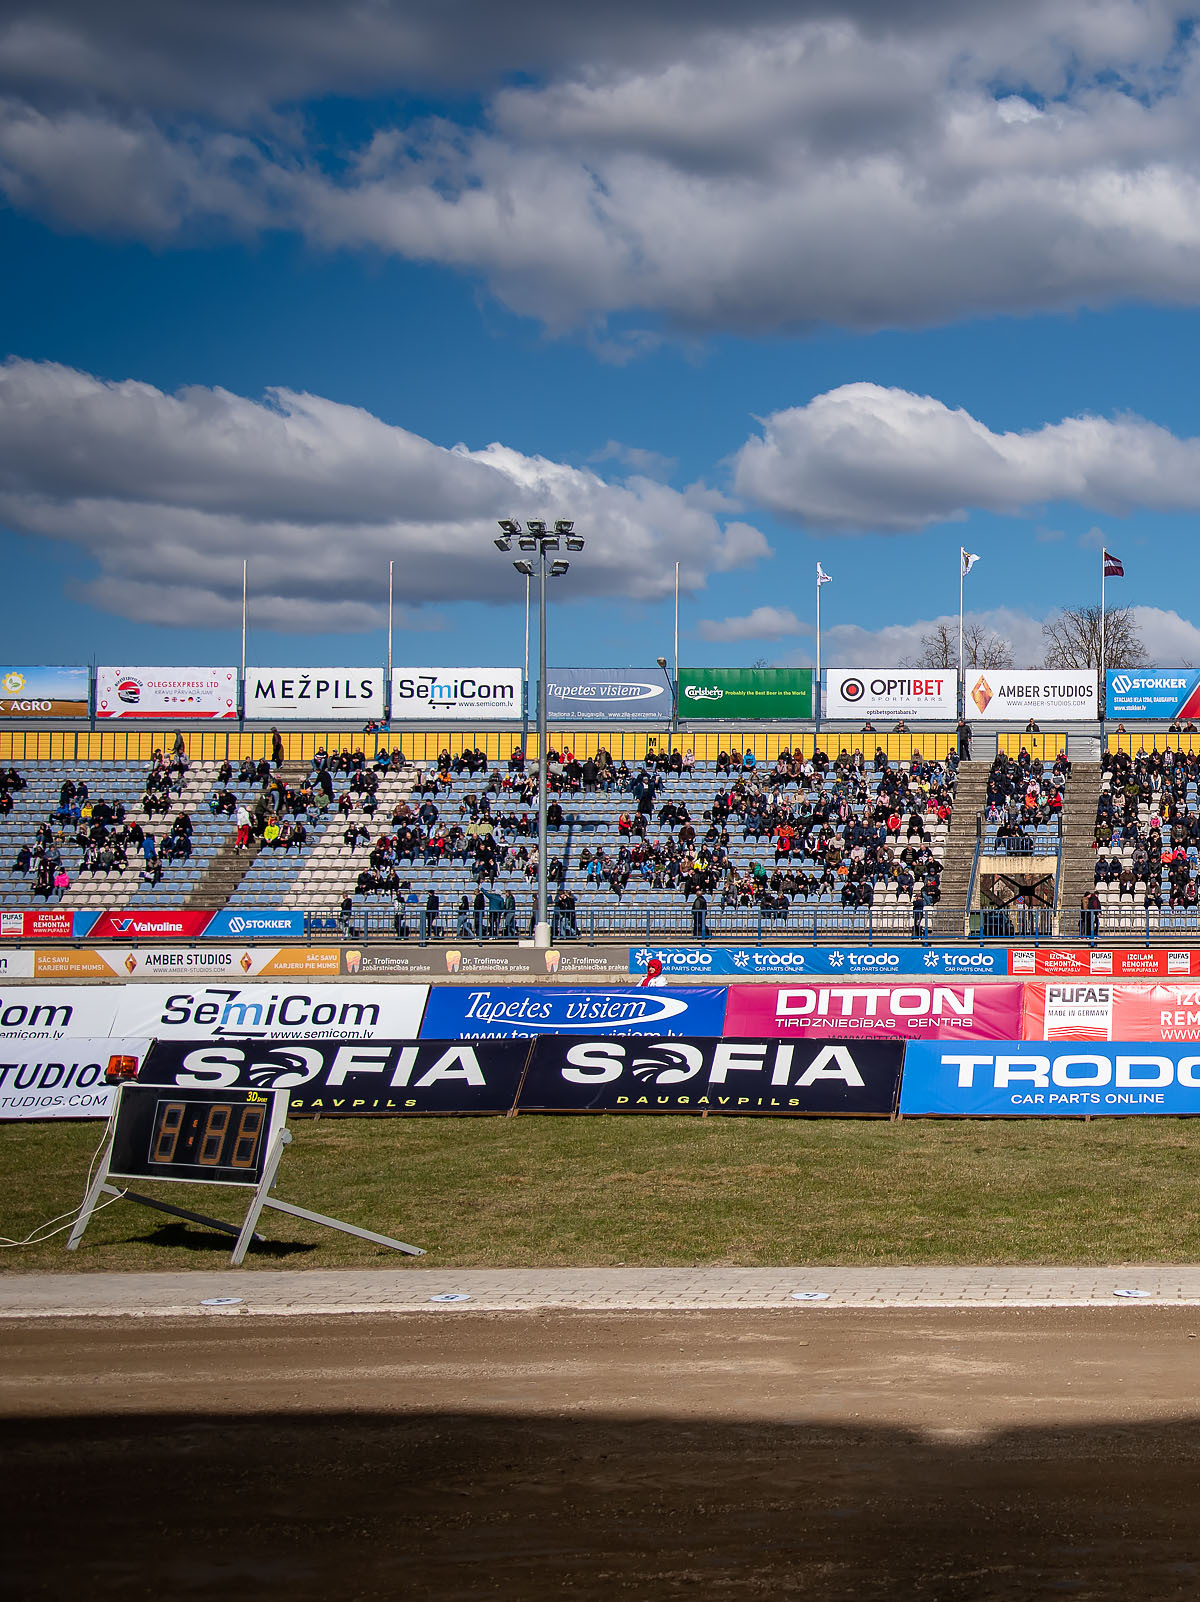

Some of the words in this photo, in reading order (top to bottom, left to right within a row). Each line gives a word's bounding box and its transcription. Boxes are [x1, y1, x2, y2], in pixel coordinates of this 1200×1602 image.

[255, 674, 373, 698] MEŽPILS
[399, 679, 514, 699] SemiCom
[870, 679, 943, 696] OPTIBET
[1131, 678, 1187, 689] STOKKER
[547, 684, 596, 700] Tapetes
[599, 685, 641, 696] visiem
[685, 685, 723, 700] Carlsberg
[999, 685, 1040, 697] AMBER
[1043, 685, 1093, 698] STUDIOS
[10, 700, 53, 711] AGRO
[648, 737, 656, 746] M
[1033, 738, 1038, 747] L
[2, 913, 23, 921] PUFAS
[38, 914, 65, 922] IZCILAM
[133, 922, 183, 932] Valvoline
[246, 920, 292, 929] STOKKER
[145, 954, 185, 966] AMBER
[187, 953, 232, 965] STUDIOS
[656, 951, 712, 965] trodo
[752, 952, 804, 965] trodo
[850, 952, 899, 965] trodo
[942, 952, 994, 965] trodo
[775, 987, 975, 1016] DITTON
[1049, 988, 1109, 1003] PUFAS
[161, 995, 381, 1026] SemiCom
[465, 991, 552, 1023] Tapetes
[566, 996, 647, 1019] visiem
[1048, 1009, 1066, 1017] MADE
[1068, 1009, 1076, 1017] IN
[1077, 1009, 1108, 1017] GERMANY
[775, 1017, 896, 1028] TIRDZNIECĪBAS
[907, 1017, 973, 1028] CENTRS
[270, 1029, 374, 1040] www.semicom.lv
[290, 1098, 418, 1108] GAVPILS
[616, 1095, 800, 1107] DAUGAVPILS
[1010, 1094, 1044, 1104] CAR
[1049, 1092, 1100, 1104] PARTS
[1105, 1093, 1165, 1104] ONLINE
